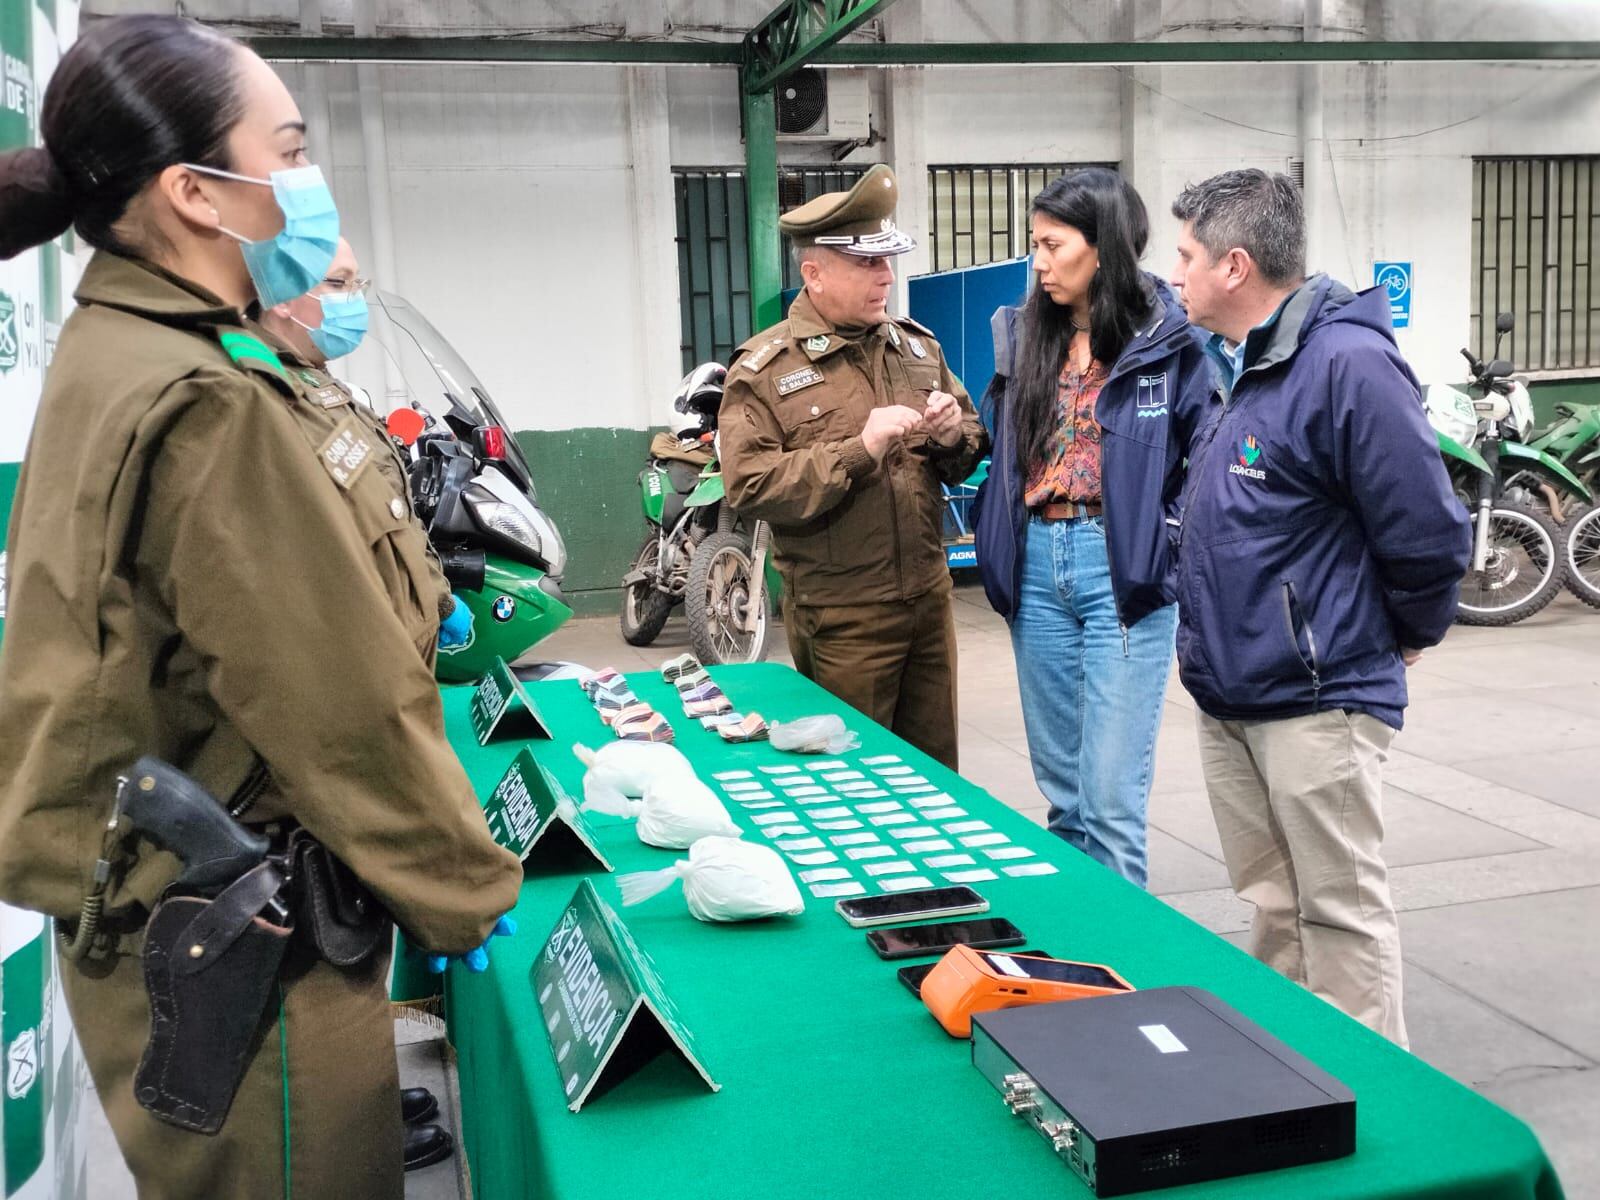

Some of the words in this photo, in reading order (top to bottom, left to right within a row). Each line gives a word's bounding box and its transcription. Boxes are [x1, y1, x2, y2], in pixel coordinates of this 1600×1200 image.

[781, 368, 816, 384] CORONEL
[790, 375, 813, 389] SALAS
[502, 772, 541, 849] EVIDENCIA
[558, 924, 617, 1059] EVIDENCIA
